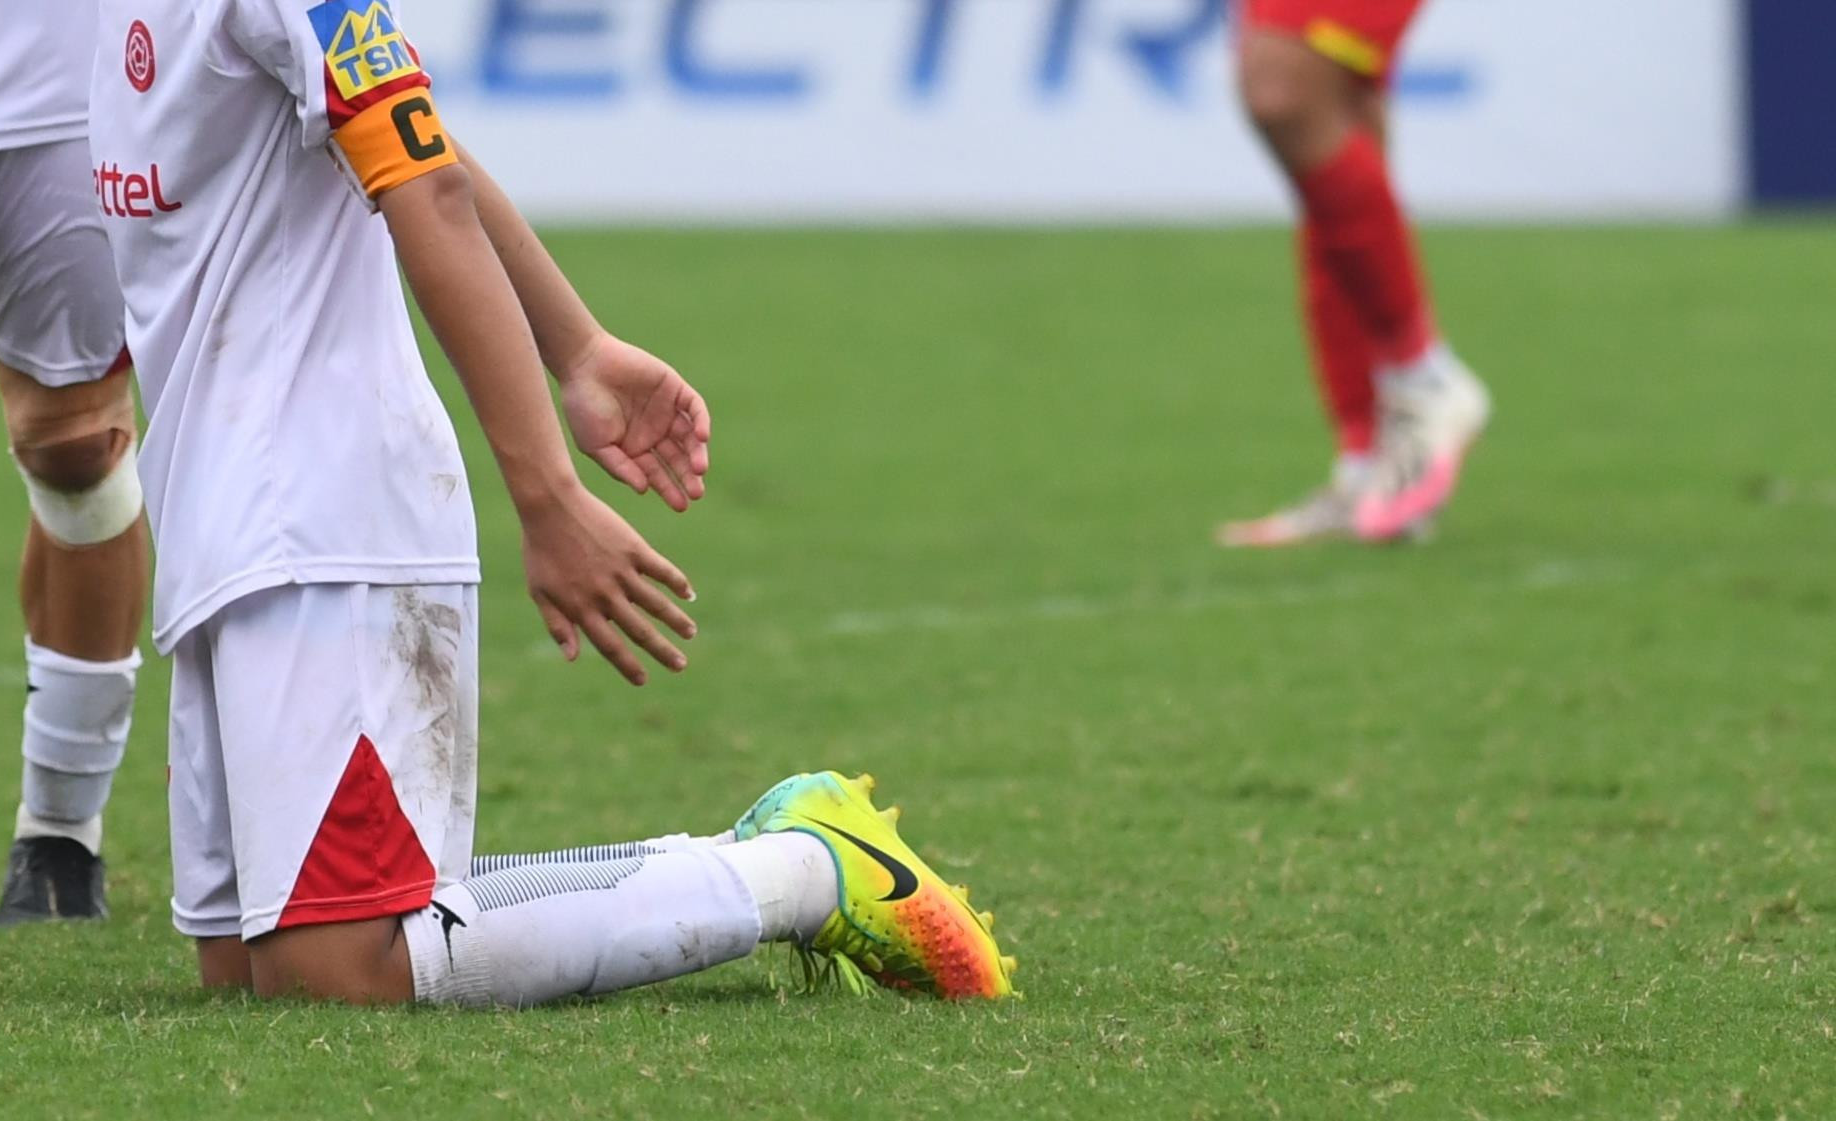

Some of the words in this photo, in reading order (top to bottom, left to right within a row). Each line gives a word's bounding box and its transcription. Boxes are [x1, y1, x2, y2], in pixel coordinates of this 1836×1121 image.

[335, 39, 413, 88] TSN
[390, 95, 446, 162] C
[93, 161, 182, 218] ttel
